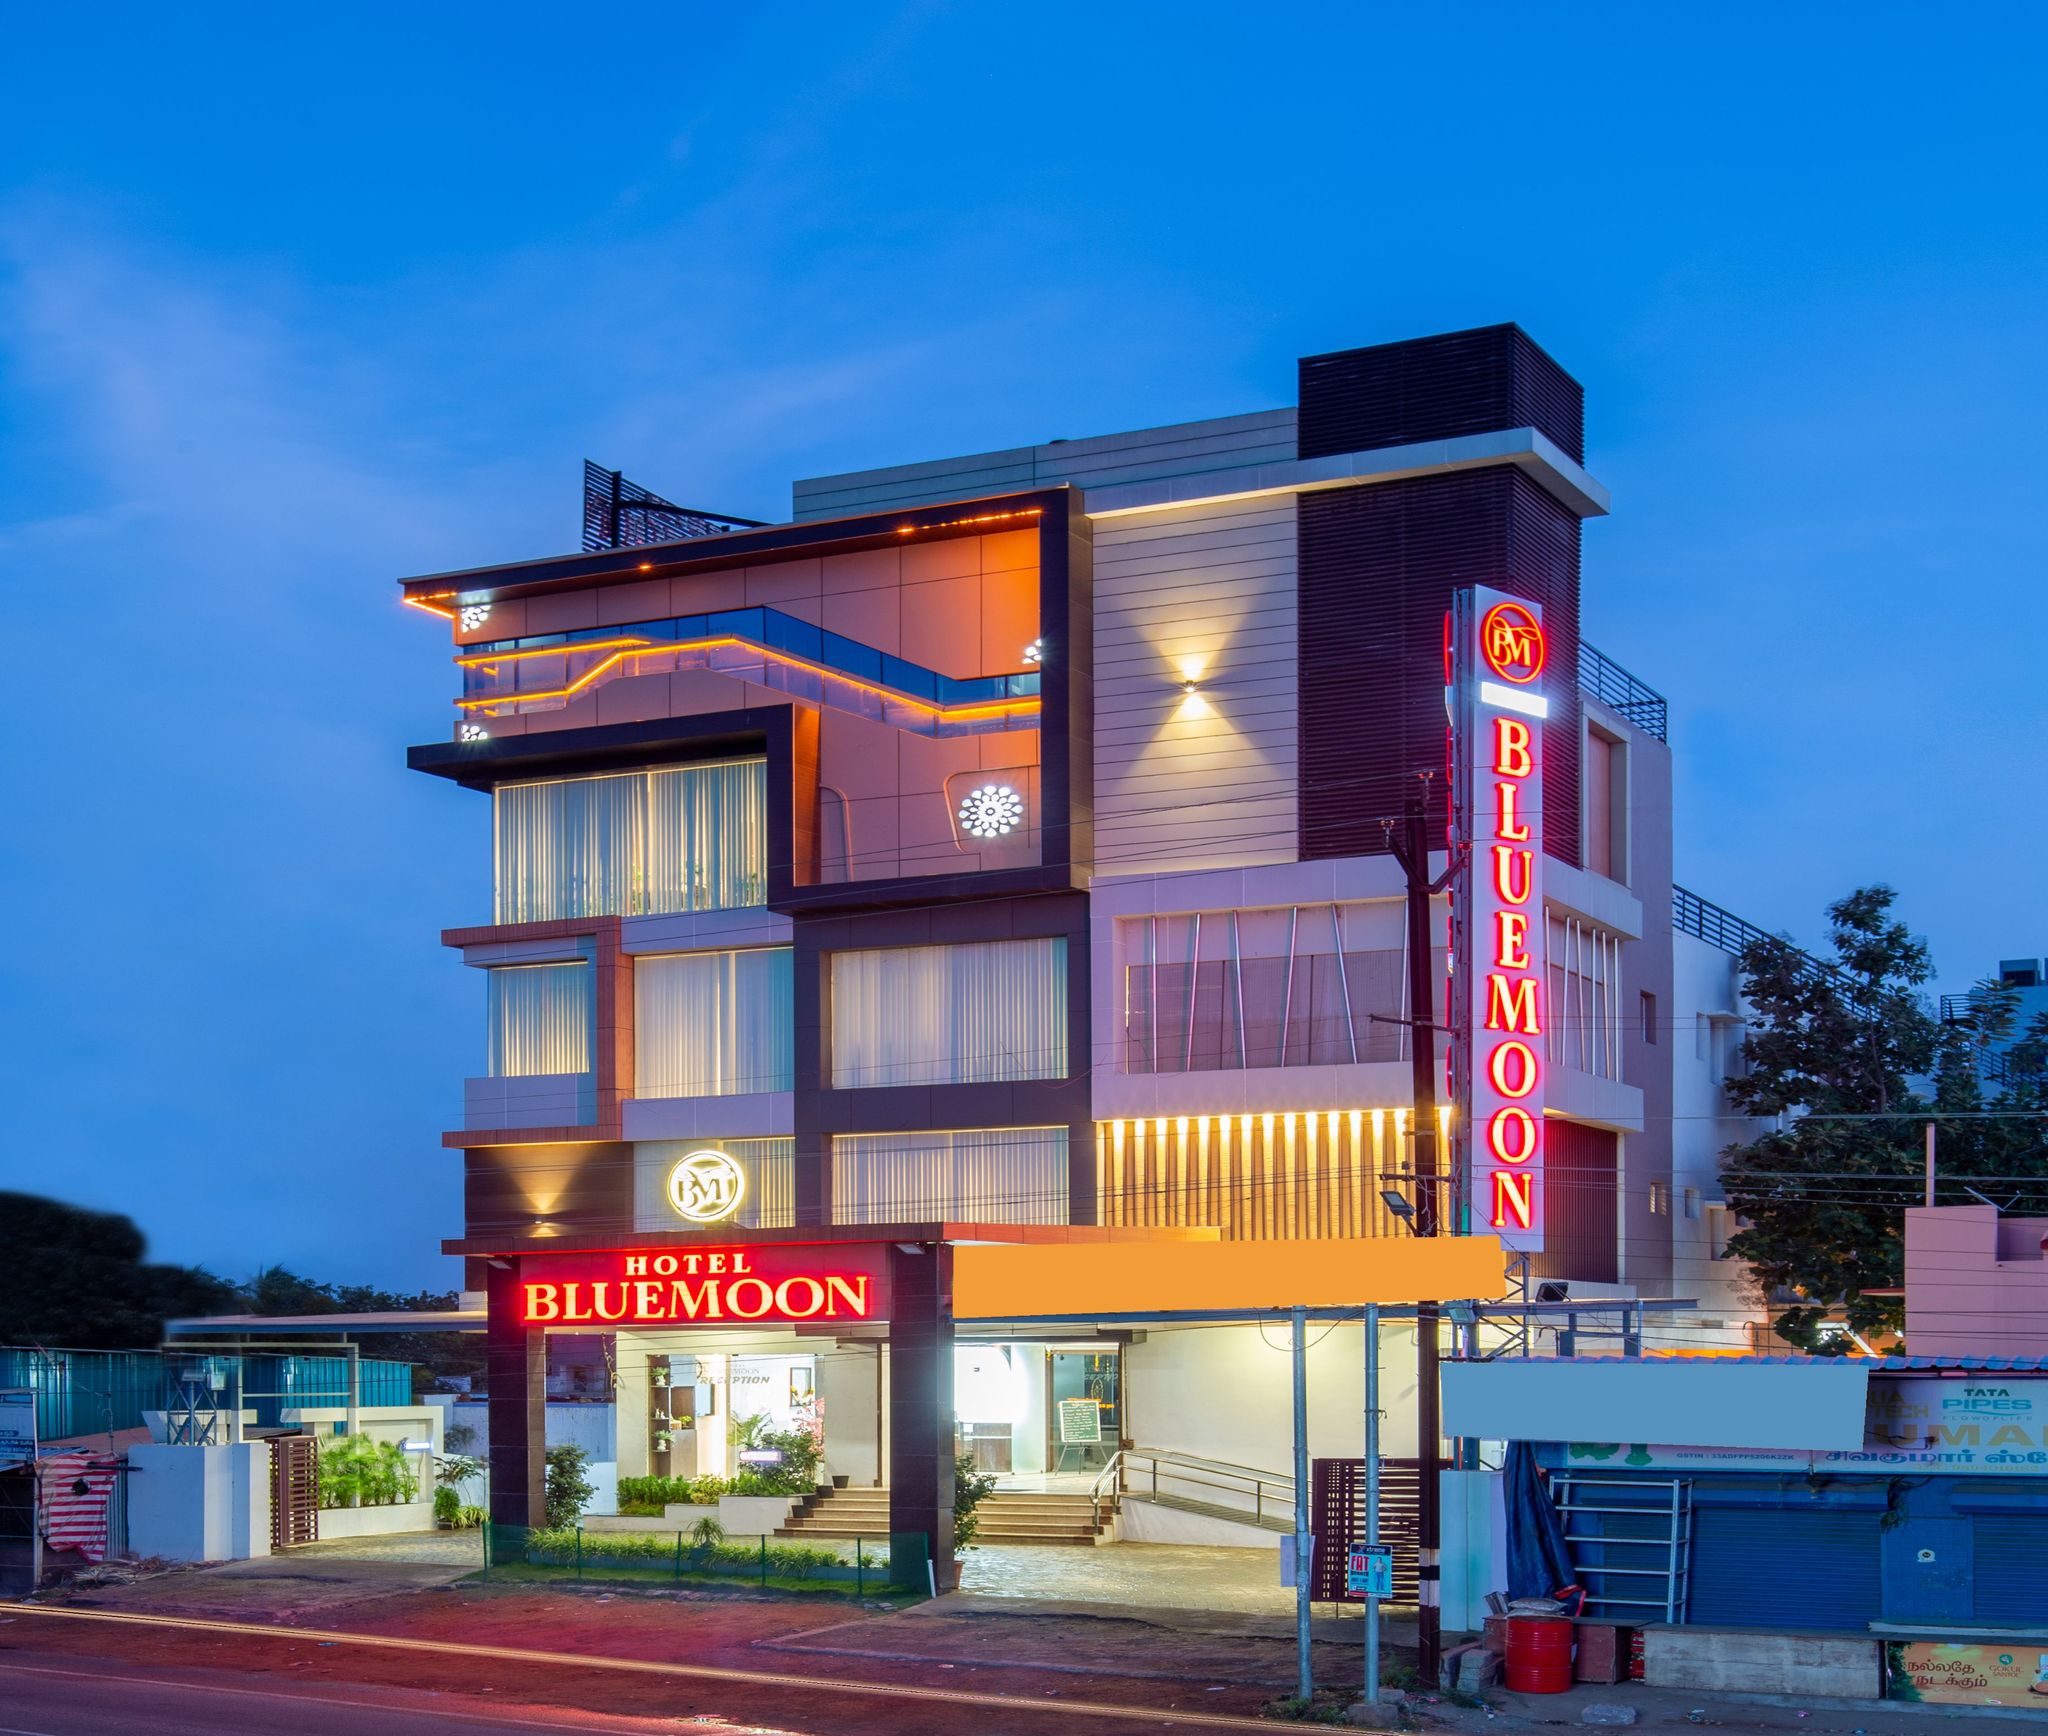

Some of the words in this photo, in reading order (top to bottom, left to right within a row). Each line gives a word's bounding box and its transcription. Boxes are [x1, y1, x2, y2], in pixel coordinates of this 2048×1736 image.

[1486, 717, 1540, 1228] BLUEMOON
[625, 1253, 751, 1276] HOTEL
[524, 1276, 867, 1321] BLUEMOON
[700, 1376, 770, 1385] RECPTION
[1964, 1388, 2010, 1397] TATA
[1942, 1399, 2032, 1410] PIPES
[1874, 1424, 2048, 1446] UMA
[1825, 1449, 1976, 1464] சிவகுமார்
[1351, 1555, 1369, 1571] FAT
[1907, 1659, 1975, 1674] நல்லதே
[1916, 1673, 1988, 1689] நடக்கும்
